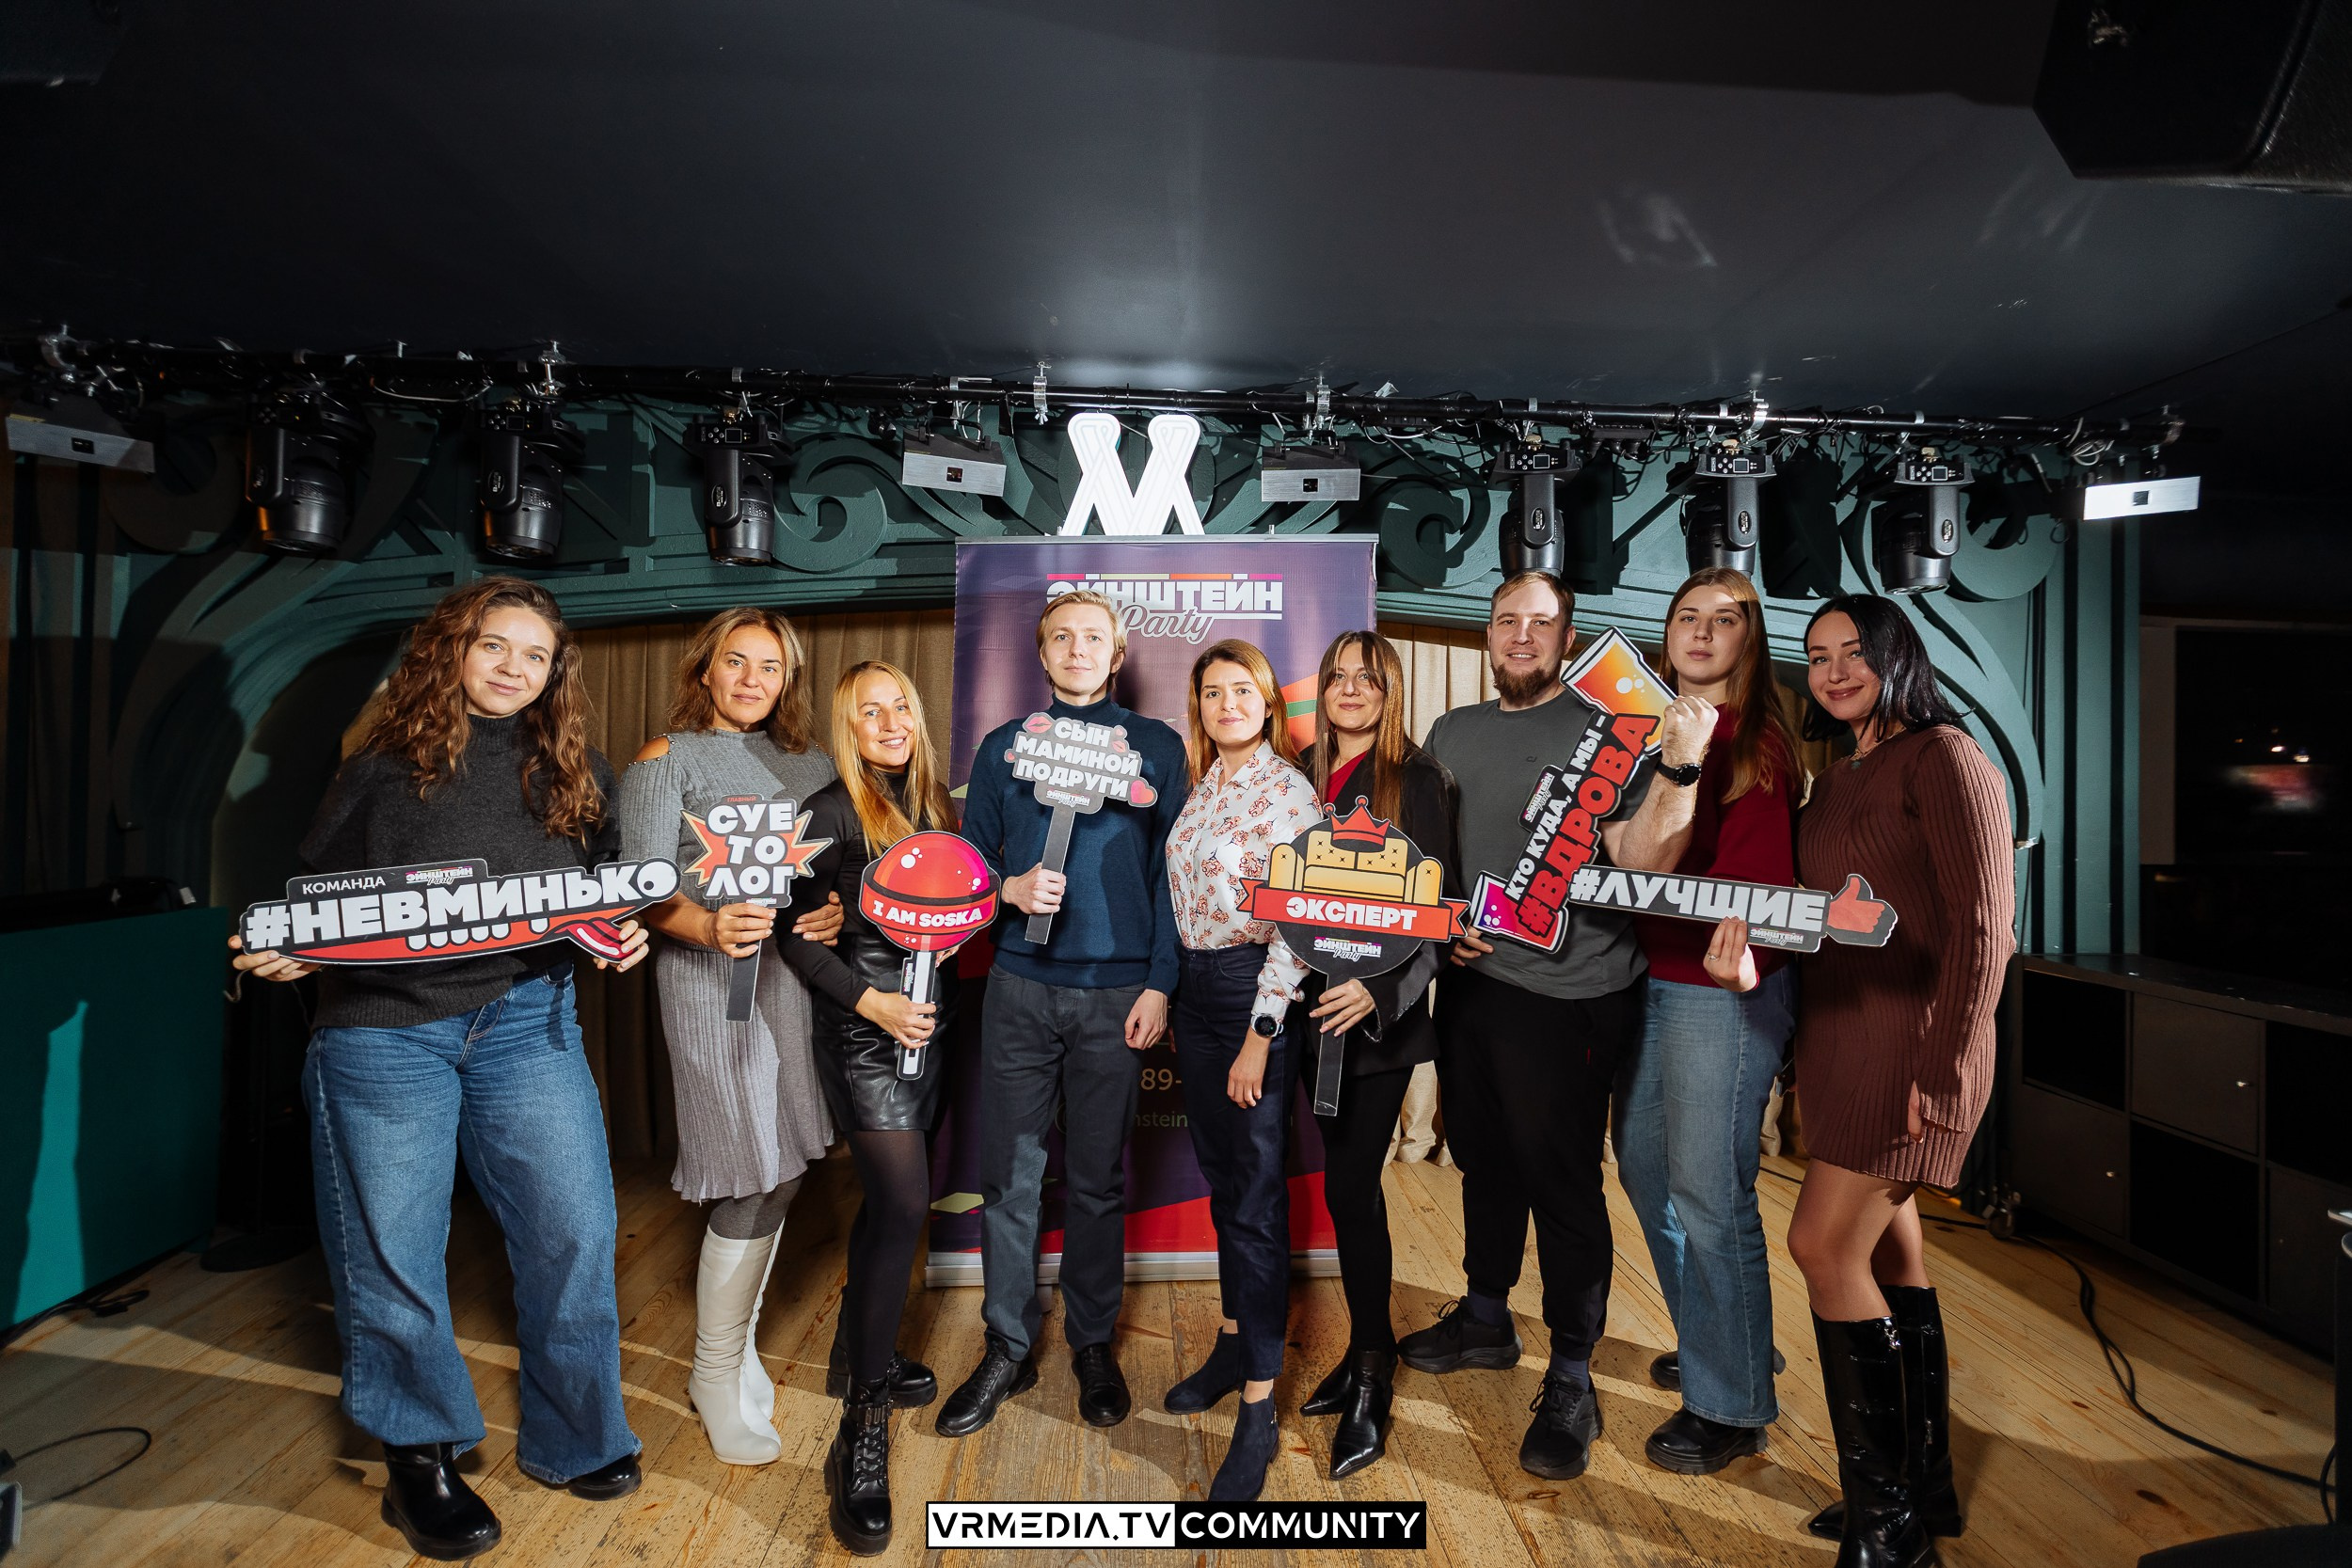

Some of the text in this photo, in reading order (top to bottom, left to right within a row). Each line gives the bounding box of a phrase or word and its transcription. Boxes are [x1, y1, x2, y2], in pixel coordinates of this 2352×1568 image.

[1118, 602, 1213, 645] Party
[1055, 721, 1111, 747] СЫН
[1569, 728, 1604, 771] МЫ
[1015, 735, 1139, 776] МАМИНОЙ
[1016, 758, 1129, 798] ПОДРУГИ
[1561, 773, 1582, 792] А
[707, 802, 793, 834] СУЕ
[1516, 716, 1658, 936] #ВДРОВА
[1526, 795, 1572, 859] КУДА,
[728, 835, 786, 864] ТО
[302, 876, 386, 895] КОМАНДА
[707, 865, 794, 896] ЛОГ
[1504, 857, 1535, 901] КТО
[246, 862, 676, 949] #НЕВМИНЬКО
[872, 899, 983, 927] I AM SOSKA
[1286, 896, 1418, 931] ЭКСПЕРТ
[1569, 868, 1826, 932] #ЛУЧШИЕ
